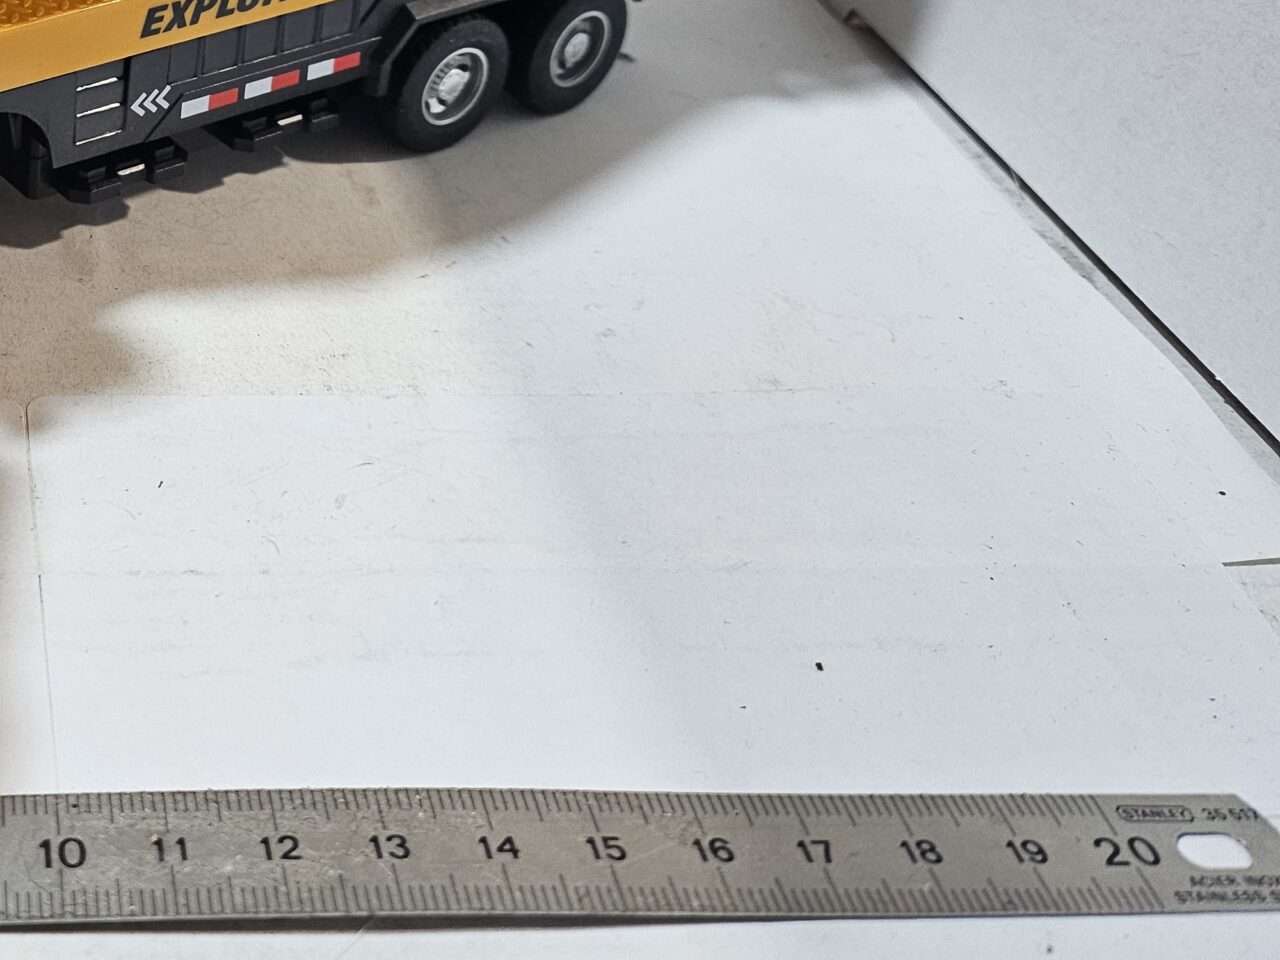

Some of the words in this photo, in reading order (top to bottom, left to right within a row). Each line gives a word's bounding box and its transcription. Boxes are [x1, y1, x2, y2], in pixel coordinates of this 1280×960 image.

[1121, 807, 1187, 820] STANLEY
[37, 837, 88, 869] 10
[151, 837, 189, 862] 11
[259, 834, 304, 861] 12
[368, 834, 412, 860] 13
[477, 834, 521, 860] 14
[585, 835, 628, 861] 15
[692, 837, 736, 863] 16
[795, 839, 834, 864] 17
[899, 839, 945, 865] 18
[1004, 839, 1050, 865] 19
[1093, 836, 1162, 866] 20
